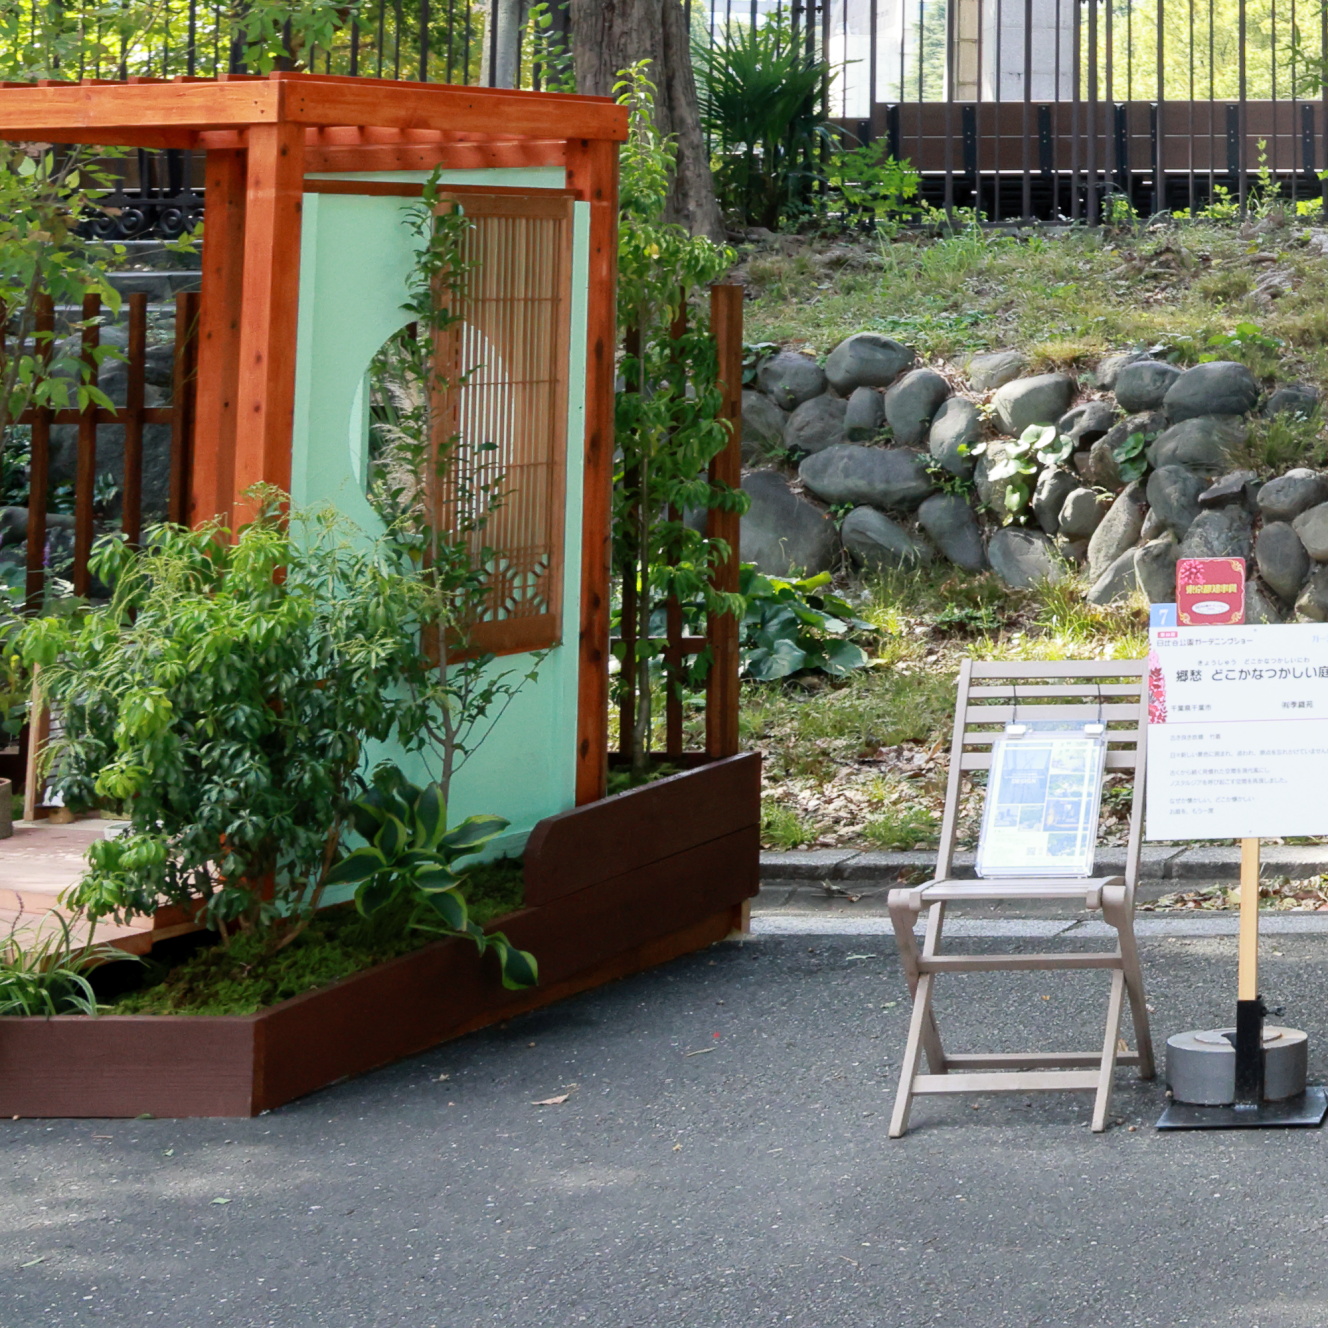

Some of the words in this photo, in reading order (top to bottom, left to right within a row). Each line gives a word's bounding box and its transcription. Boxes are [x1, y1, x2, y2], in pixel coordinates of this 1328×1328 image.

[1158, 608, 1169, 625] 7
[1156, 637, 1254, 647] 日比谷公園ガーデニングショー
[1244, 657, 1310, 665] どこかなつかしいにわ
[1176, 669, 1202, 682] 郷愁
[1171, 703, 1212, 712] 千葉県千葉市
